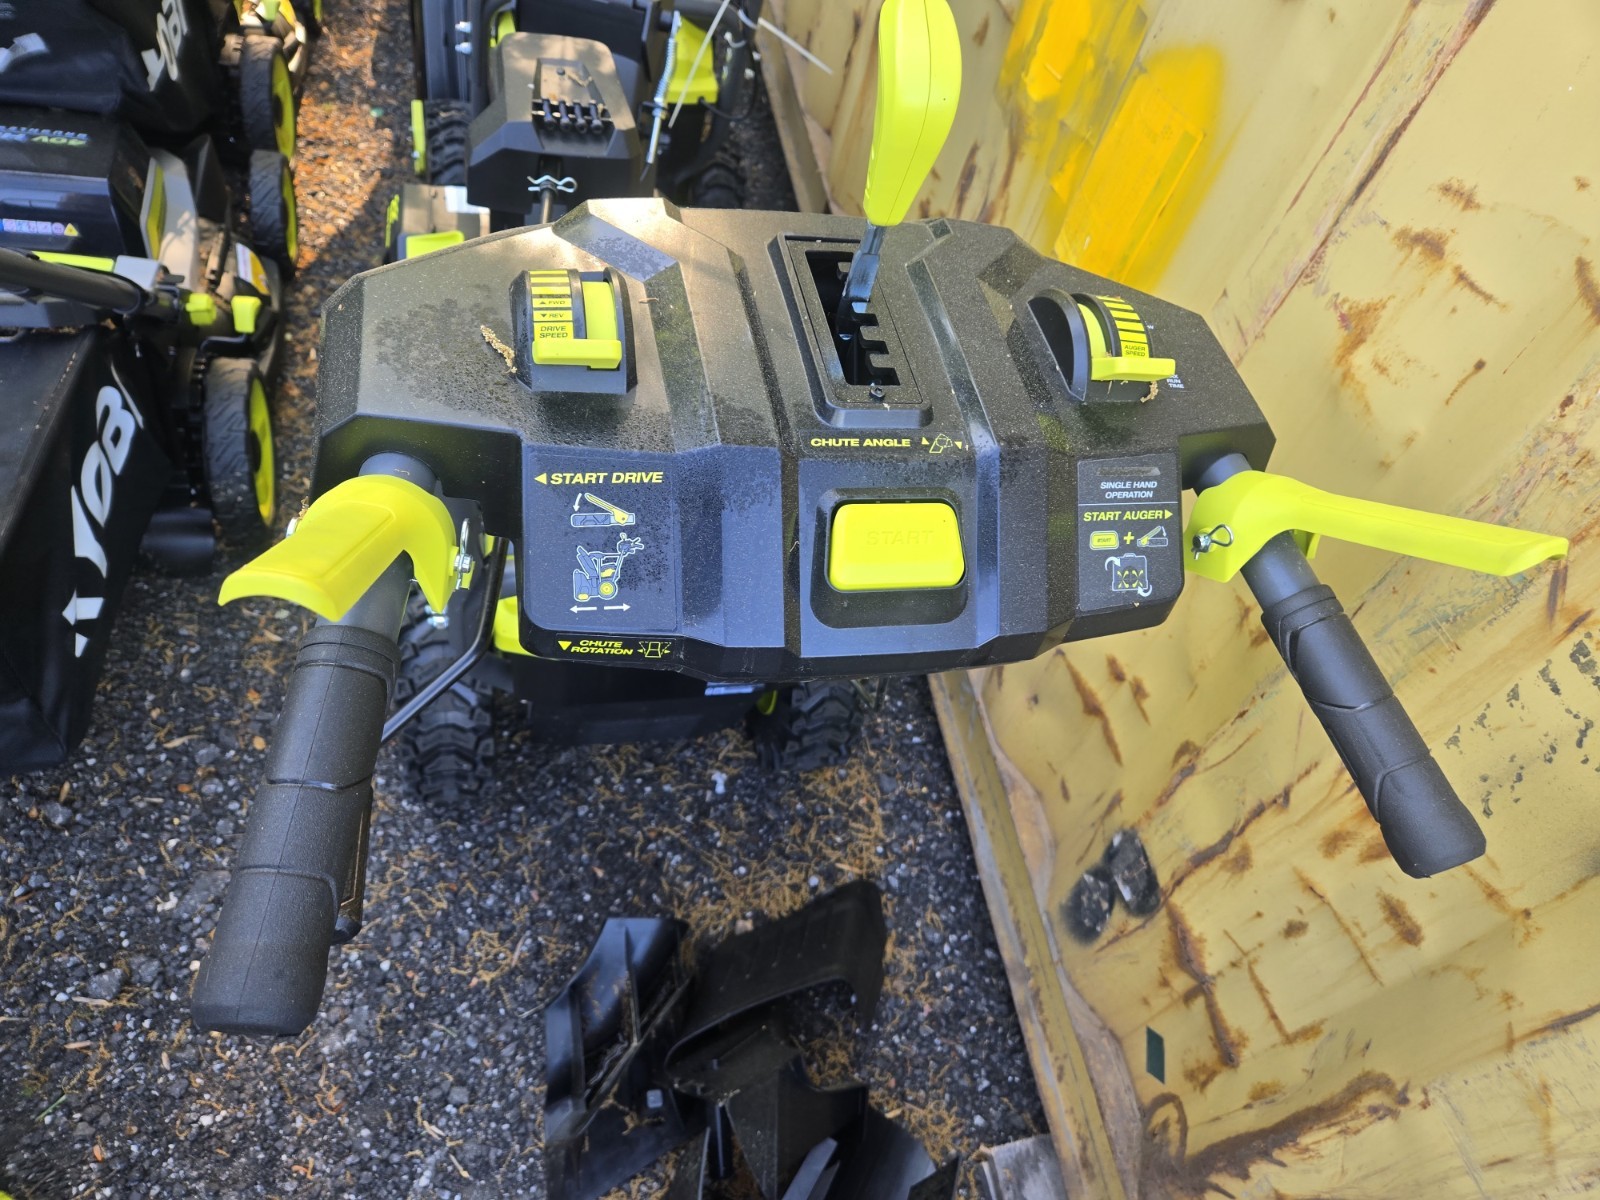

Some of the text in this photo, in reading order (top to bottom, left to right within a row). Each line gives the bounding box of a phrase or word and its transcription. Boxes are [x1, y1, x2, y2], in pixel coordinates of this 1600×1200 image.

[810, 438, 911, 447] CHUTE ANGLE
[550, 471, 664, 485] START DRIVE
[1100, 480, 1157, 489] SINGLE HAND
[1105, 490, 1153, 498] OPERATION
[1083, 510, 1163, 522] START AUGER
[865, 530, 934, 546] START
[579, 639, 623, 648] CHUTE
[570, 646, 634, 656] ROTATION
